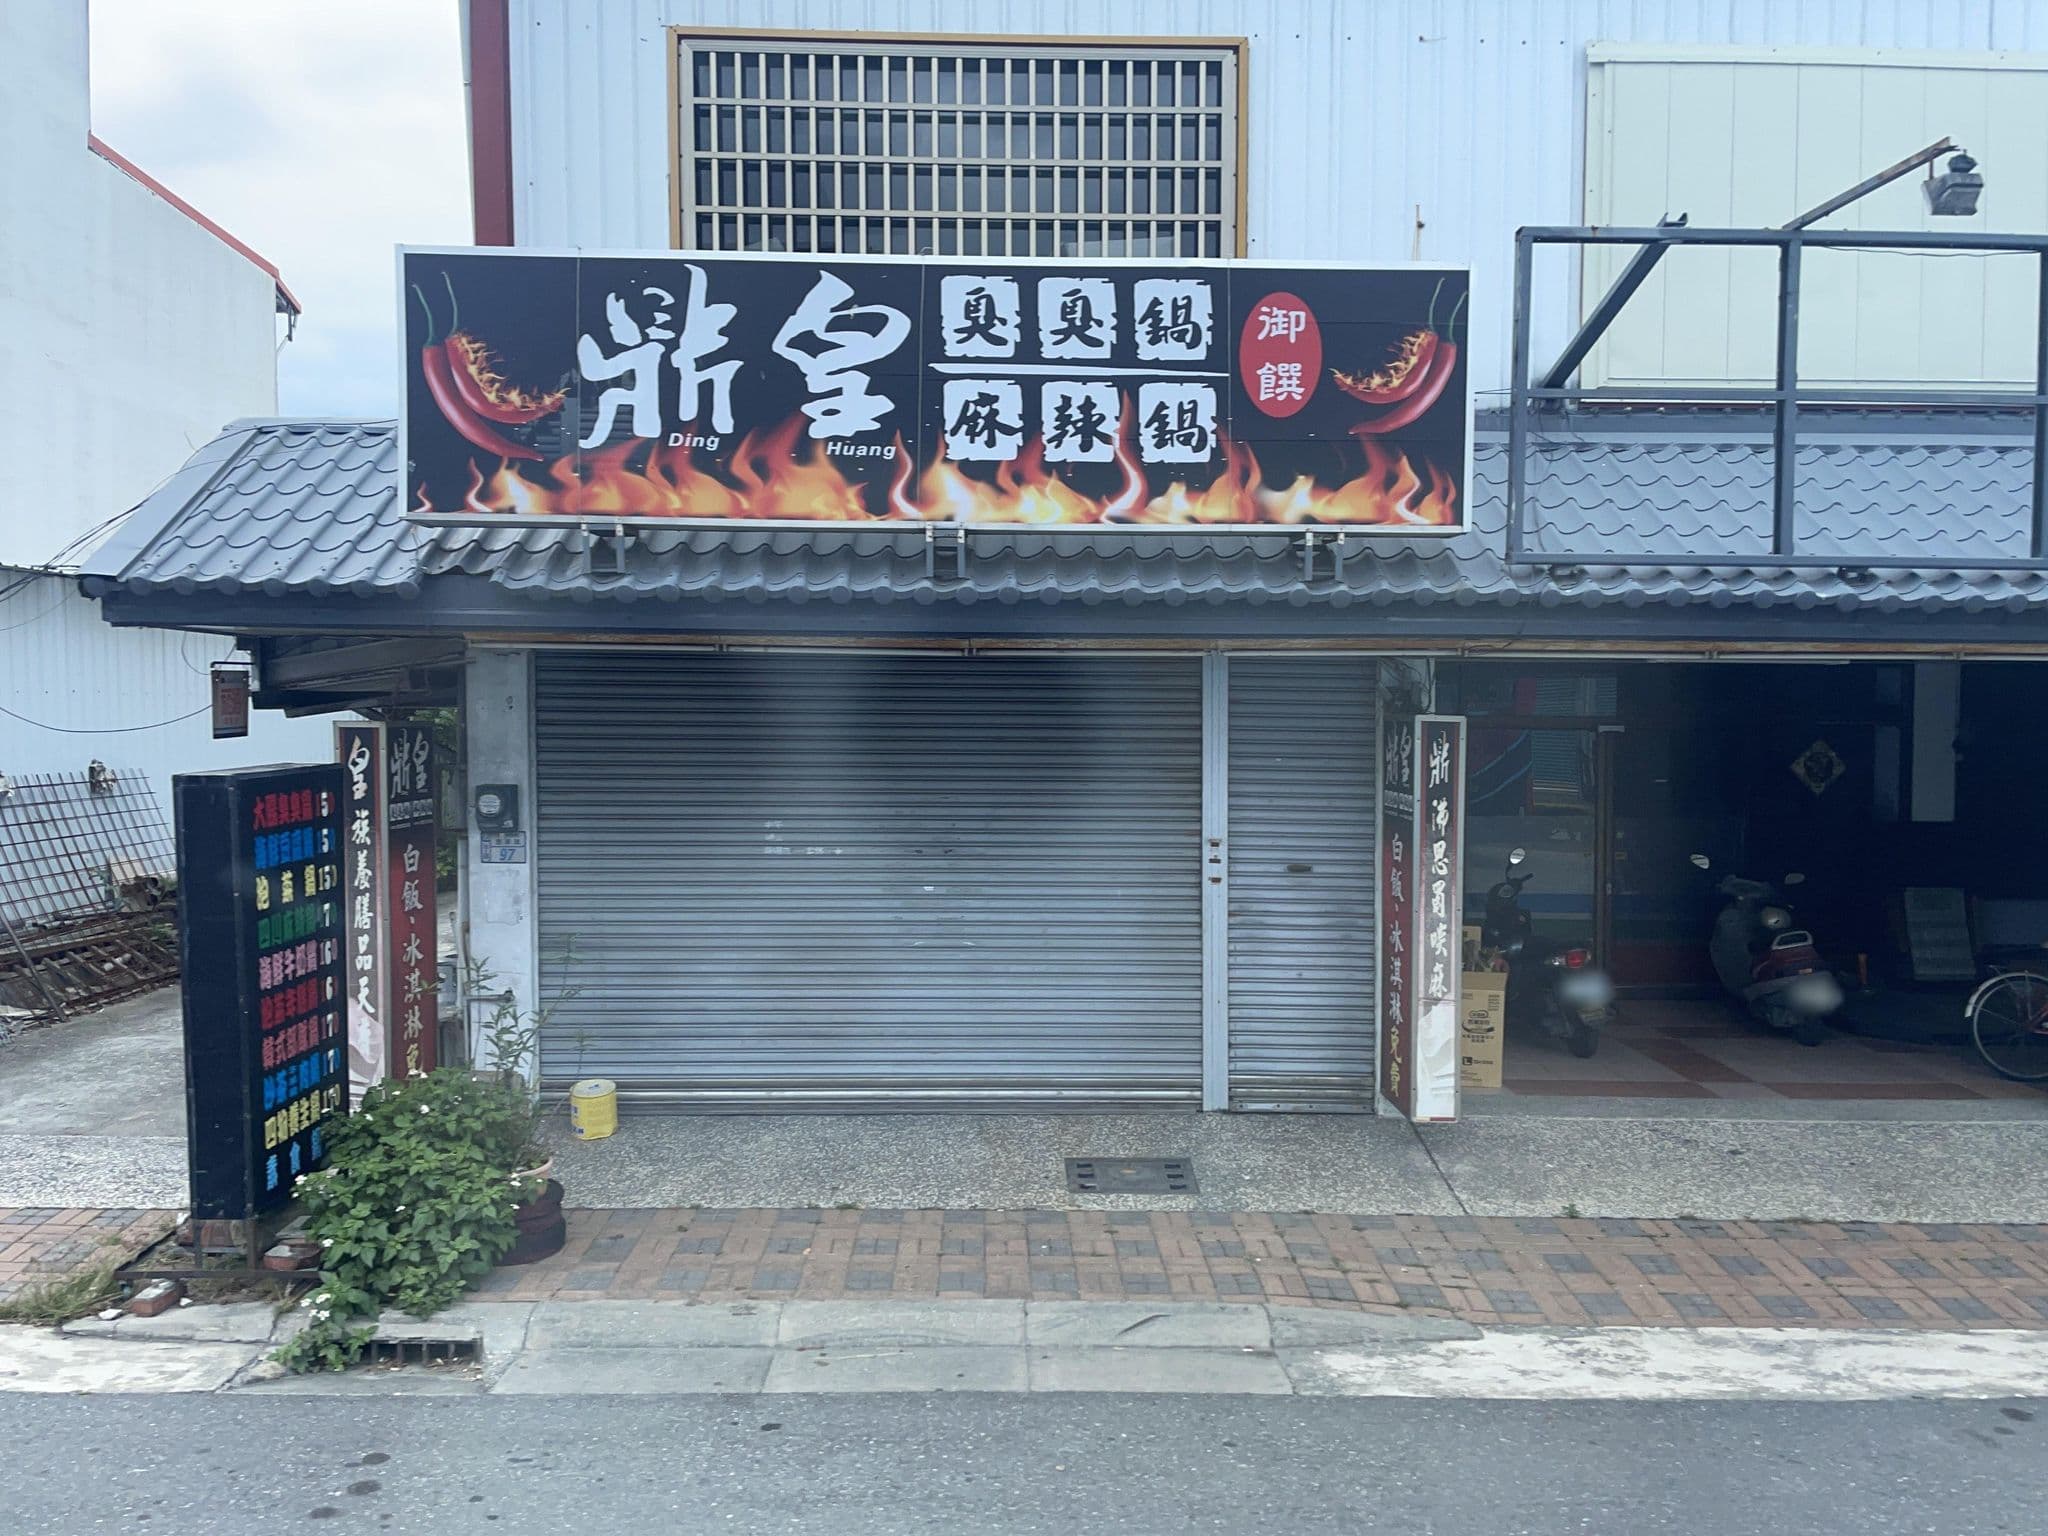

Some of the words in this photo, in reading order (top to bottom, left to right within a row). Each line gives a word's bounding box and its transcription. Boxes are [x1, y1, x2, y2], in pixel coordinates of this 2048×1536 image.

[953, 286, 1198, 349] 臭臭鍋
[577, 263, 912, 449] 鼎皇
[1257, 304, 1305, 402] 御饌
[667, 431, 721, 451] Ding
[825, 440, 897, 460] Huang
[949, 389, 1208, 453] 麻辣鍋
[390, 727, 429, 798] 鼎皇
[499, 848, 516, 861] 97
